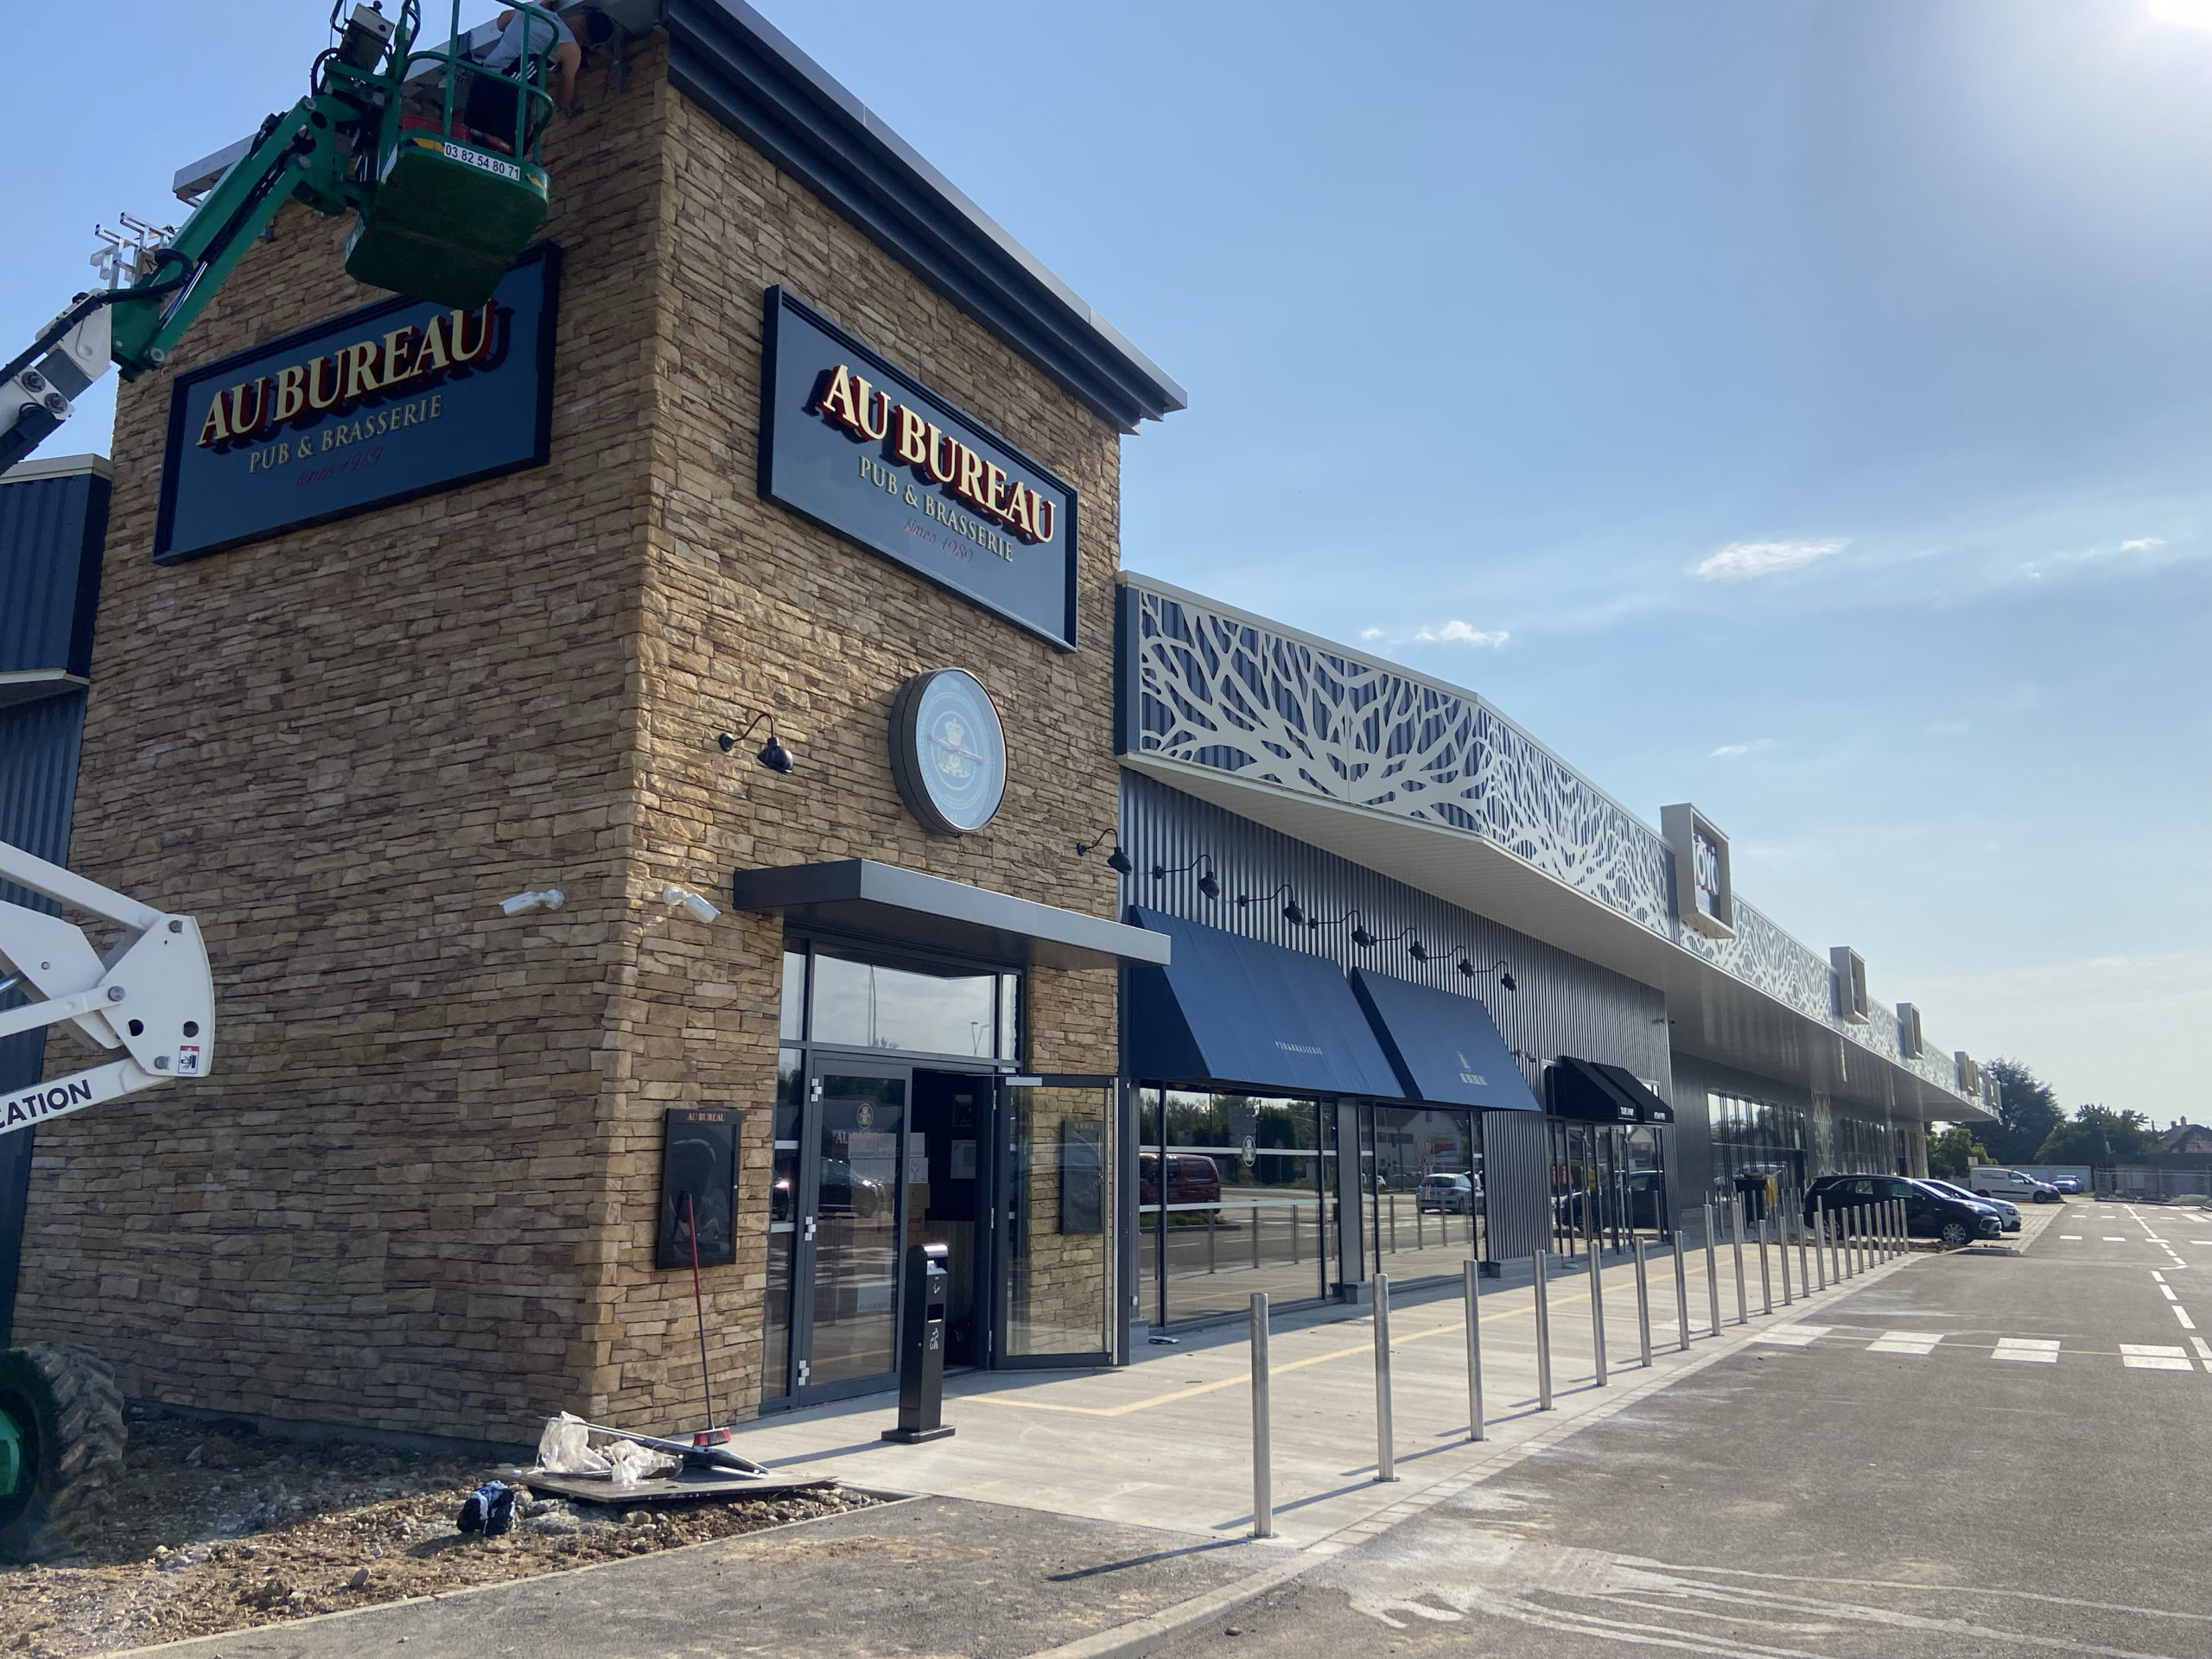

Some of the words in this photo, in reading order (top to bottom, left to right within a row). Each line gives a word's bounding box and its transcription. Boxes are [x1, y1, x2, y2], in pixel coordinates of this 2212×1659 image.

[446, 144, 458, 157] 03
[461, 150, 474, 163] 82
[477, 156, 489, 168] 54
[493, 161, 505, 174] 80
[509, 166, 519, 179] 71
[196, 375, 266, 447] AU
[273, 299, 496, 422] BUREAU
[249, 442, 290, 474] PUB
[297, 435, 315, 459] &
[321, 394, 443, 452] BRASSERIE
[819, 364, 891, 442] AU
[895, 404, 1057, 544] BUREAU
[858, 455, 899, 496] PUB
[904, 484, 919, 509] &
[924, 493, 1014, 563] BRASSERIE
[942, 537, 974, 563] 1989
[0, 1079, 92, 1128] ATION
[687, 1112, 697, 1121] AU
